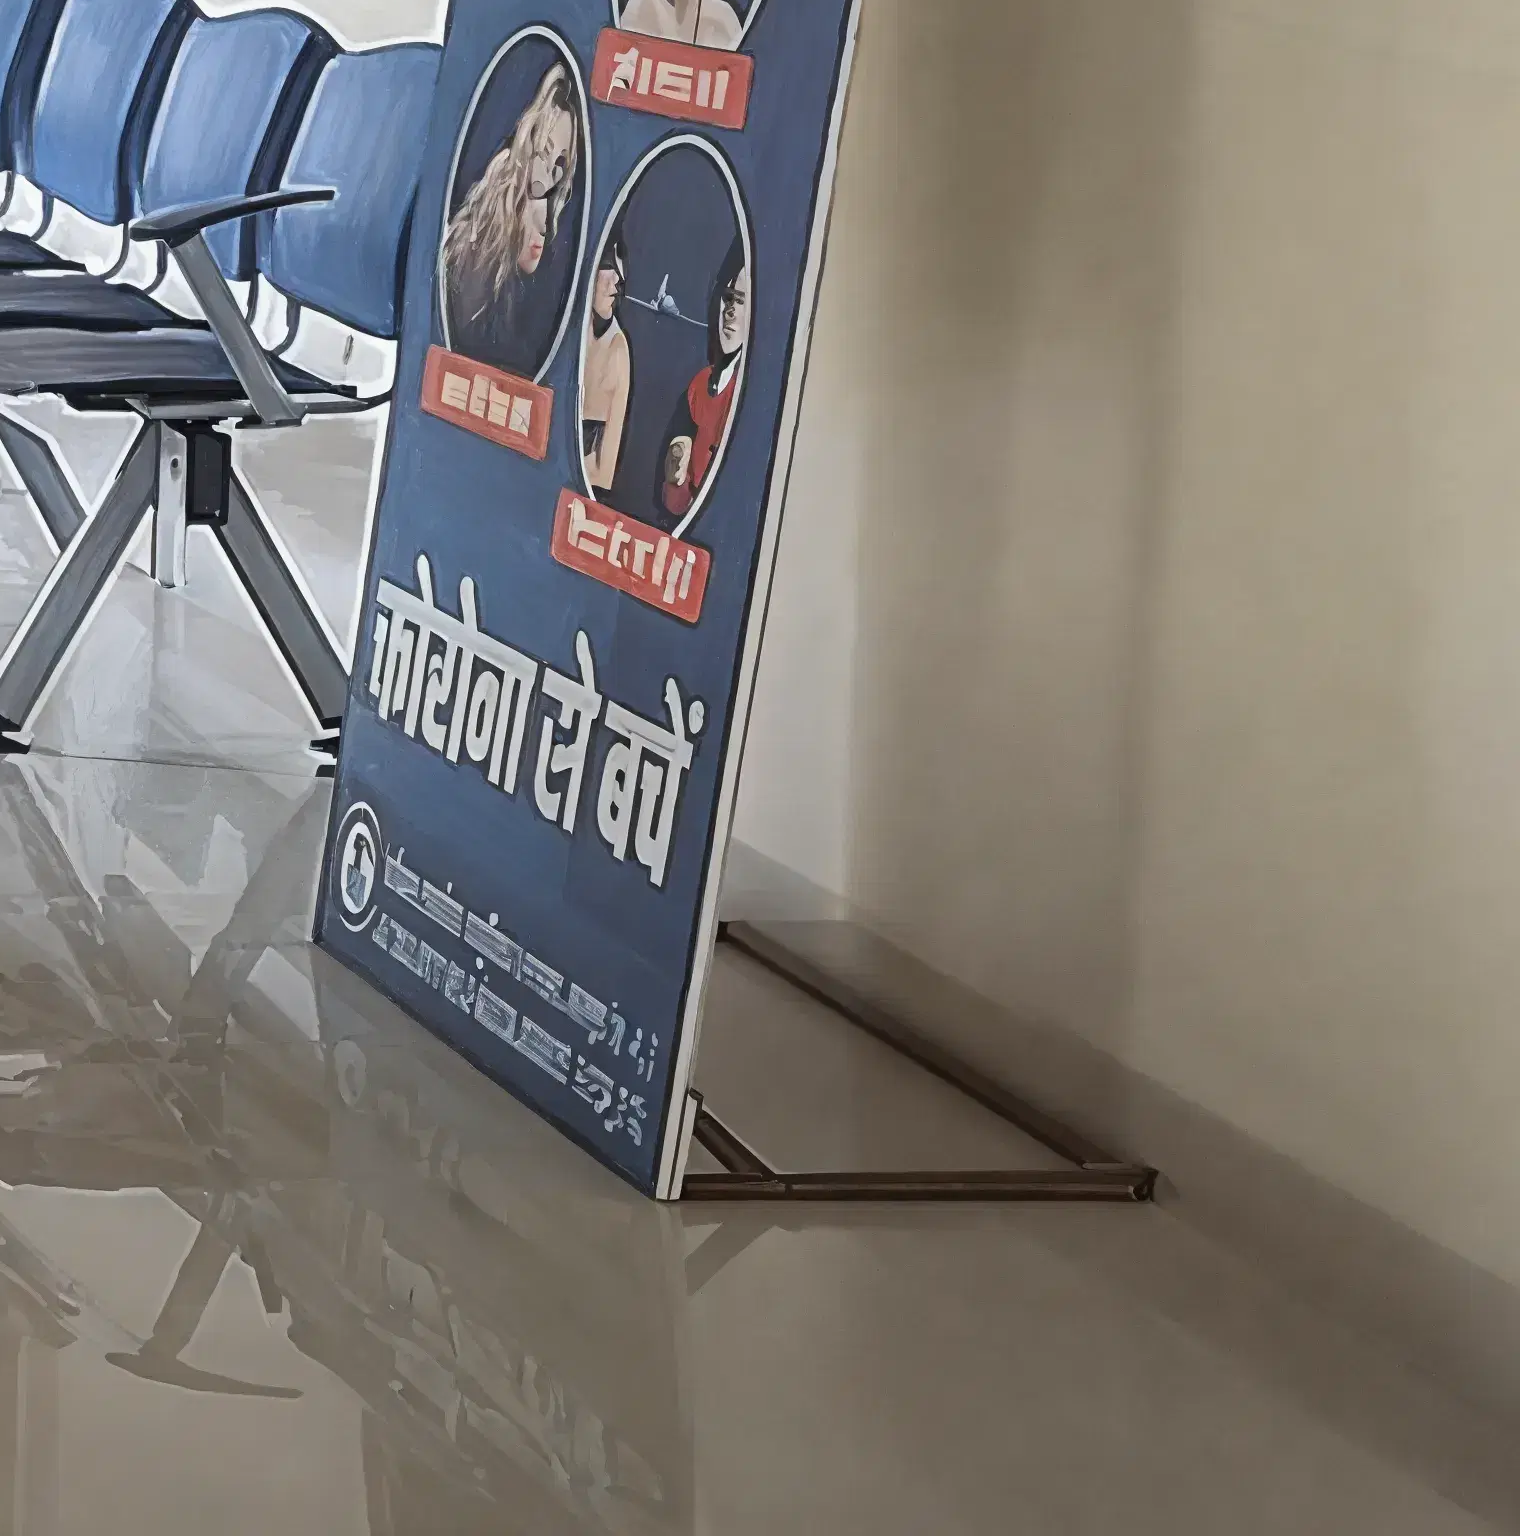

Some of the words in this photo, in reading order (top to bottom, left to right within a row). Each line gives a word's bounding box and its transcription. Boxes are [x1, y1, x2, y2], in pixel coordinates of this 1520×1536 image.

[369, 554, 539, 795] कोरोना
[534, 630, 602, 834] से
[597, 677, 705, 887] बचें
